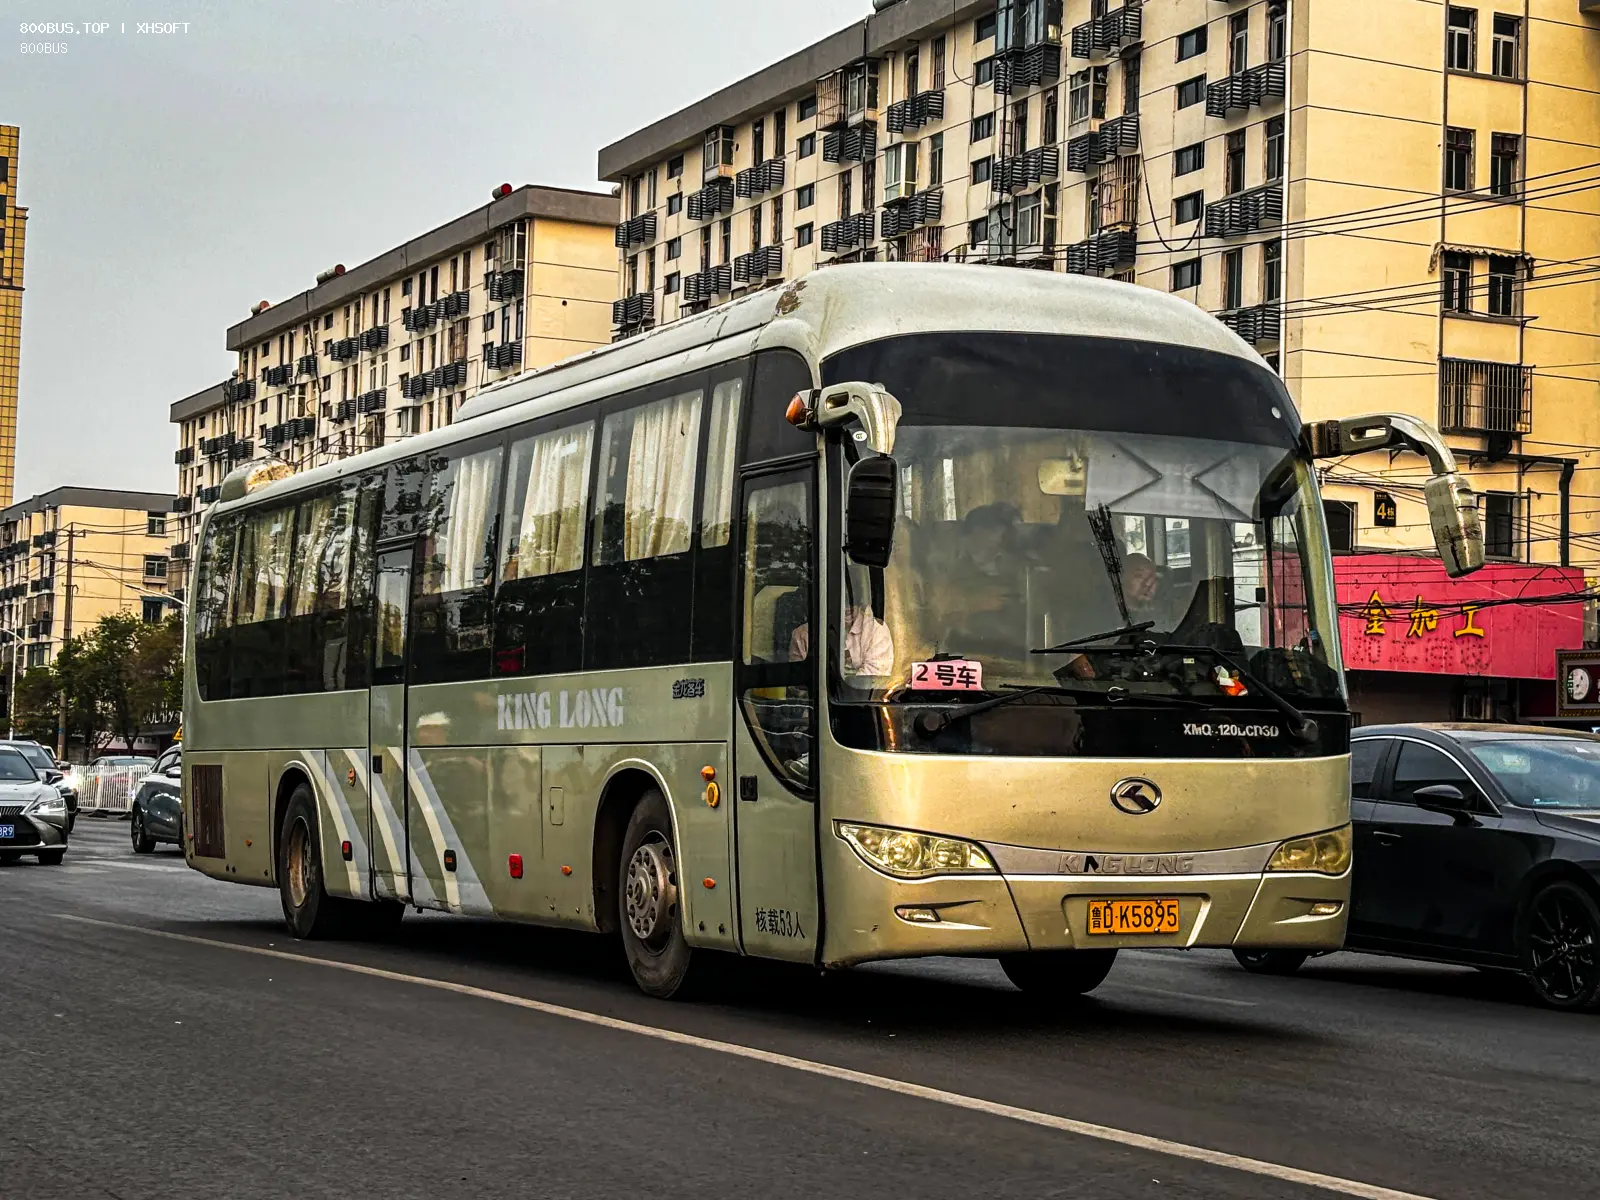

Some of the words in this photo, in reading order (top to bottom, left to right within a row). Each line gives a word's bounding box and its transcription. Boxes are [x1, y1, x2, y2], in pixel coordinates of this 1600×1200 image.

[1360, 590, 1484, 637] 金加工
[498, 691, 551, 730] KING
[559, 687, 624, 728] LONG
[755, 907, 806, 939] 核载53人
